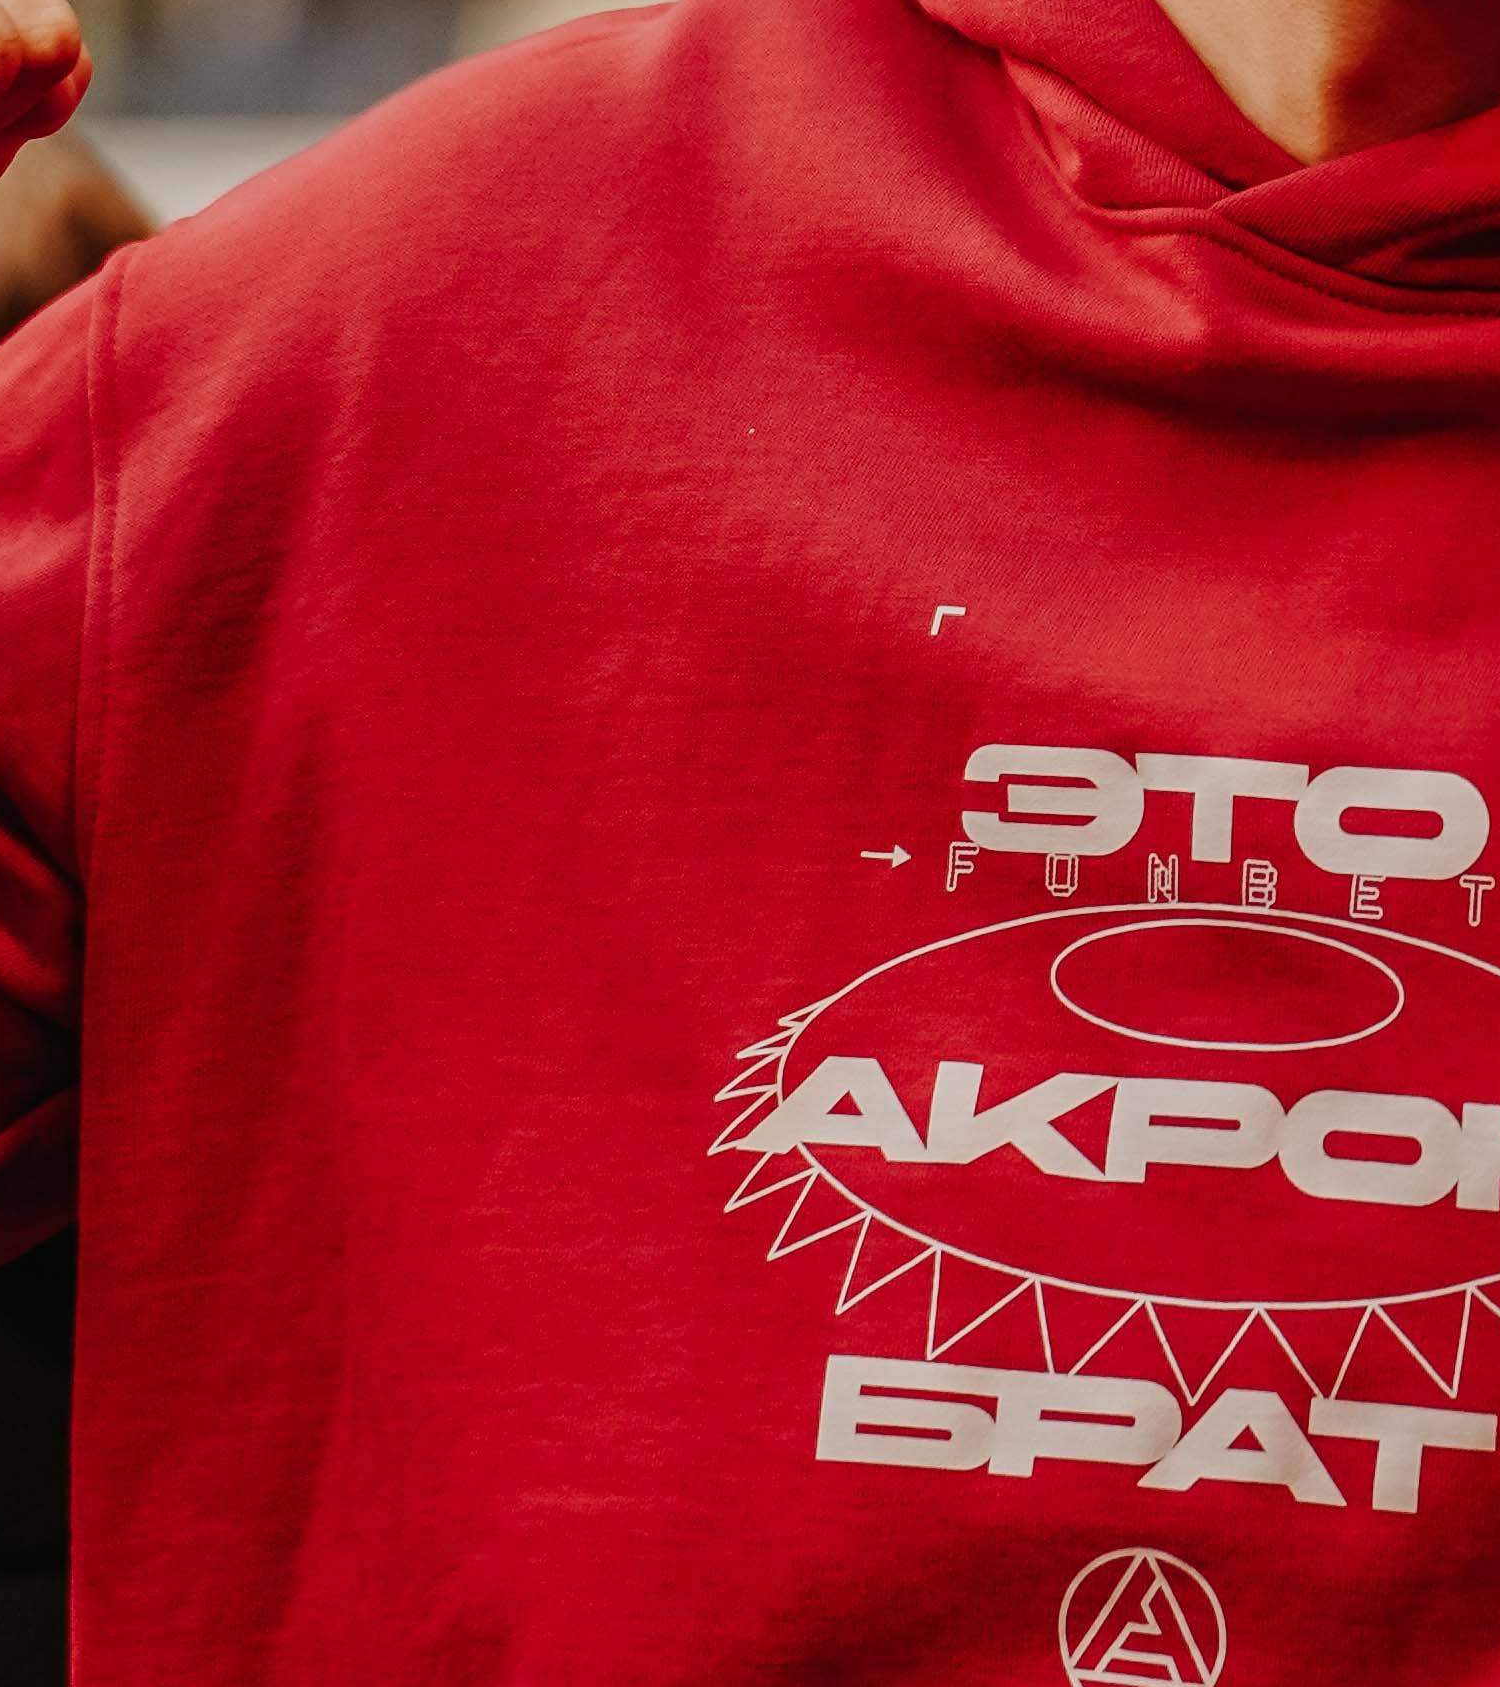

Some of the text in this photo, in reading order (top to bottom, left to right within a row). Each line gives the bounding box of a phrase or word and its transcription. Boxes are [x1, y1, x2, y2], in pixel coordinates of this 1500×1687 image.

[961, 743, 1491, 880] ЭТО
[945, 841, 1496, 927] FONBET
[815, 1353, 1498, 1514] БРАТ
